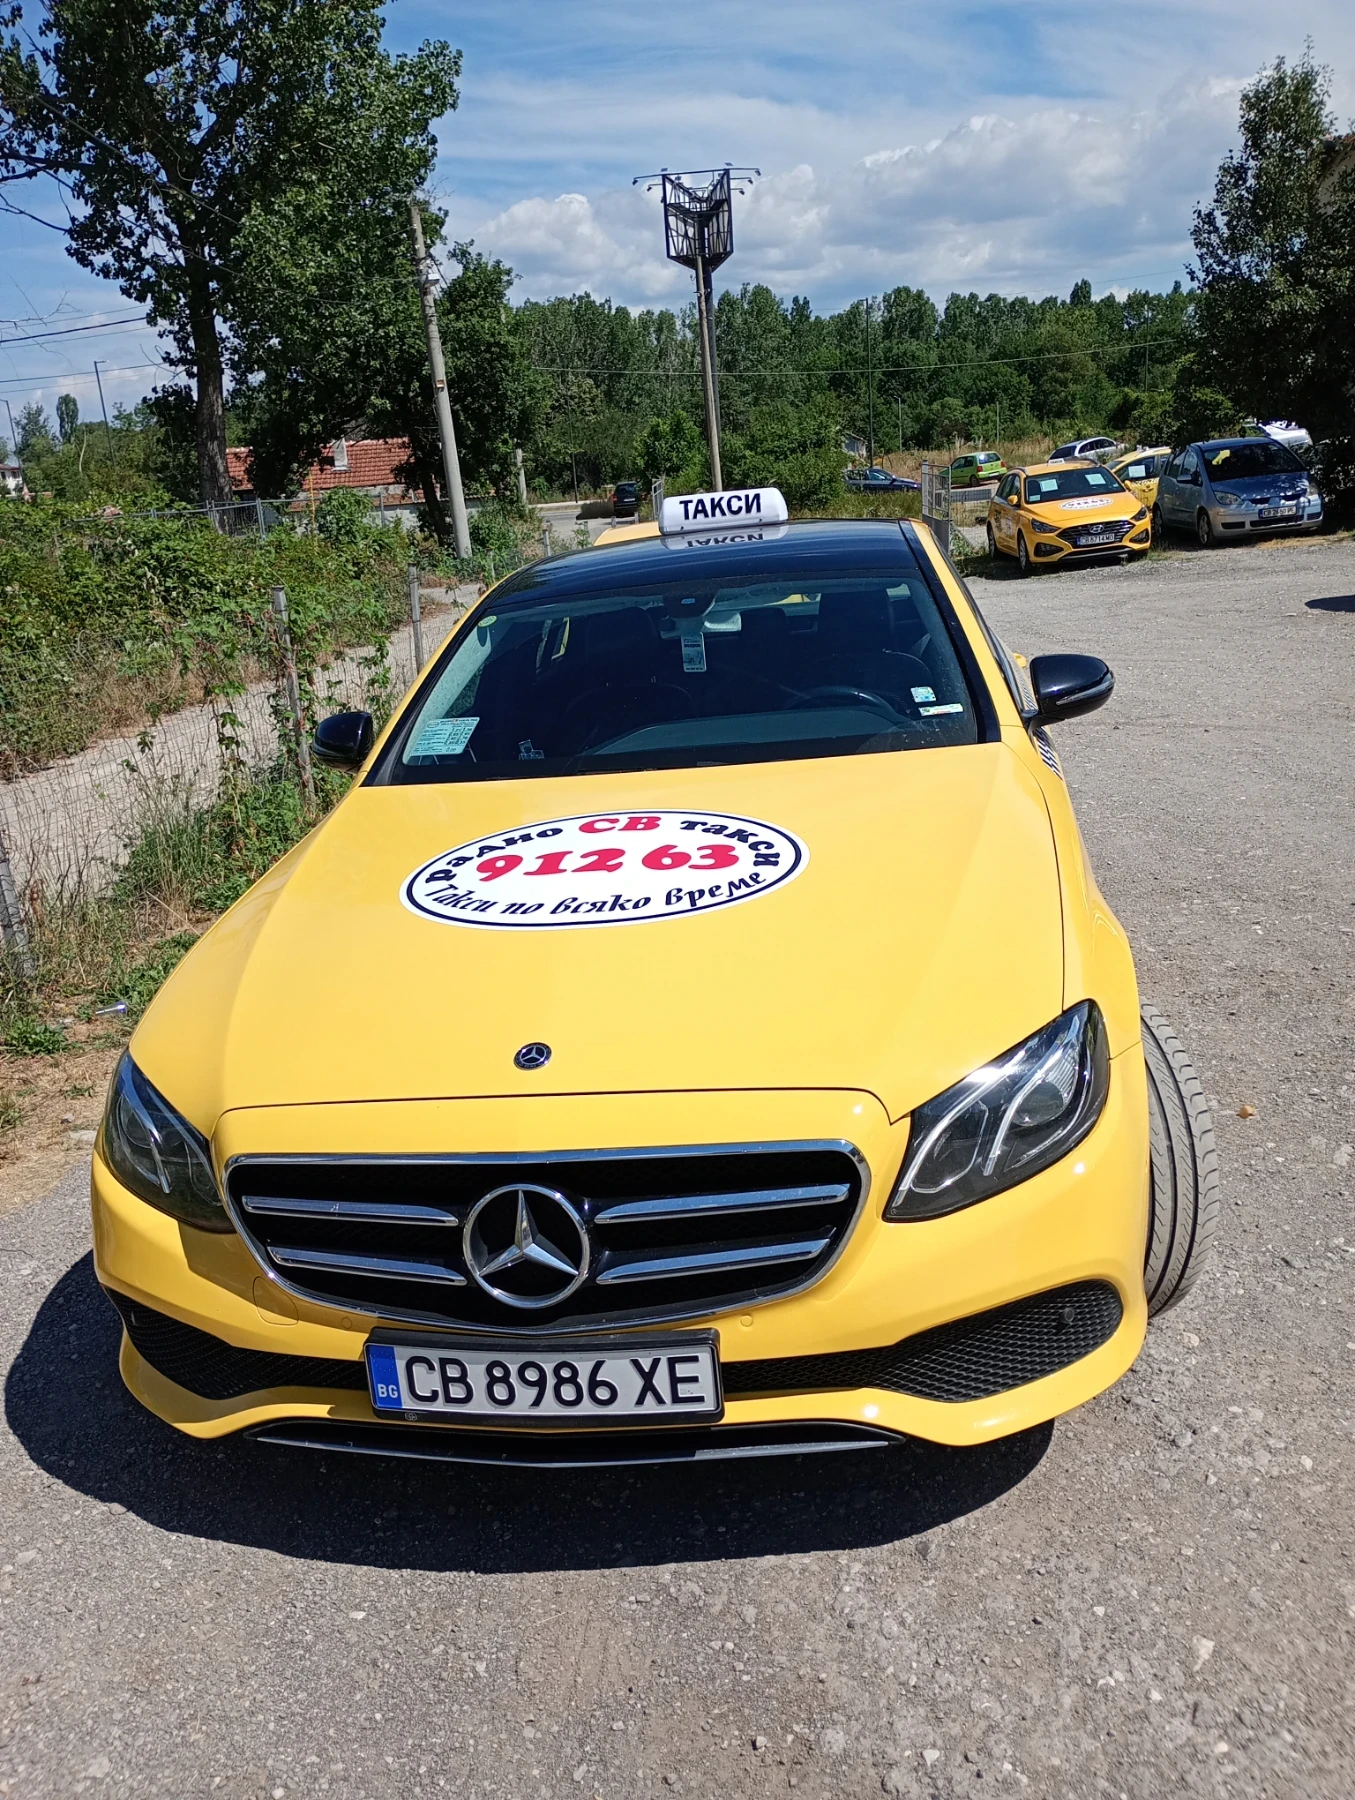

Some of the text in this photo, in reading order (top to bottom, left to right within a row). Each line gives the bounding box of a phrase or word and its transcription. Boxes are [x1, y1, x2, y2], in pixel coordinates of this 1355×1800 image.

[679, 493, 762, 520] ТАКСИ
[425, 828, 563, 883] радио
[680, 820, 780, 867] такси
[424, 872, 766, 914] Такси по всяко време
[378, 1383, 399, 1399] BG
[405, 1355, 706, 1407] CB 8986 XE
